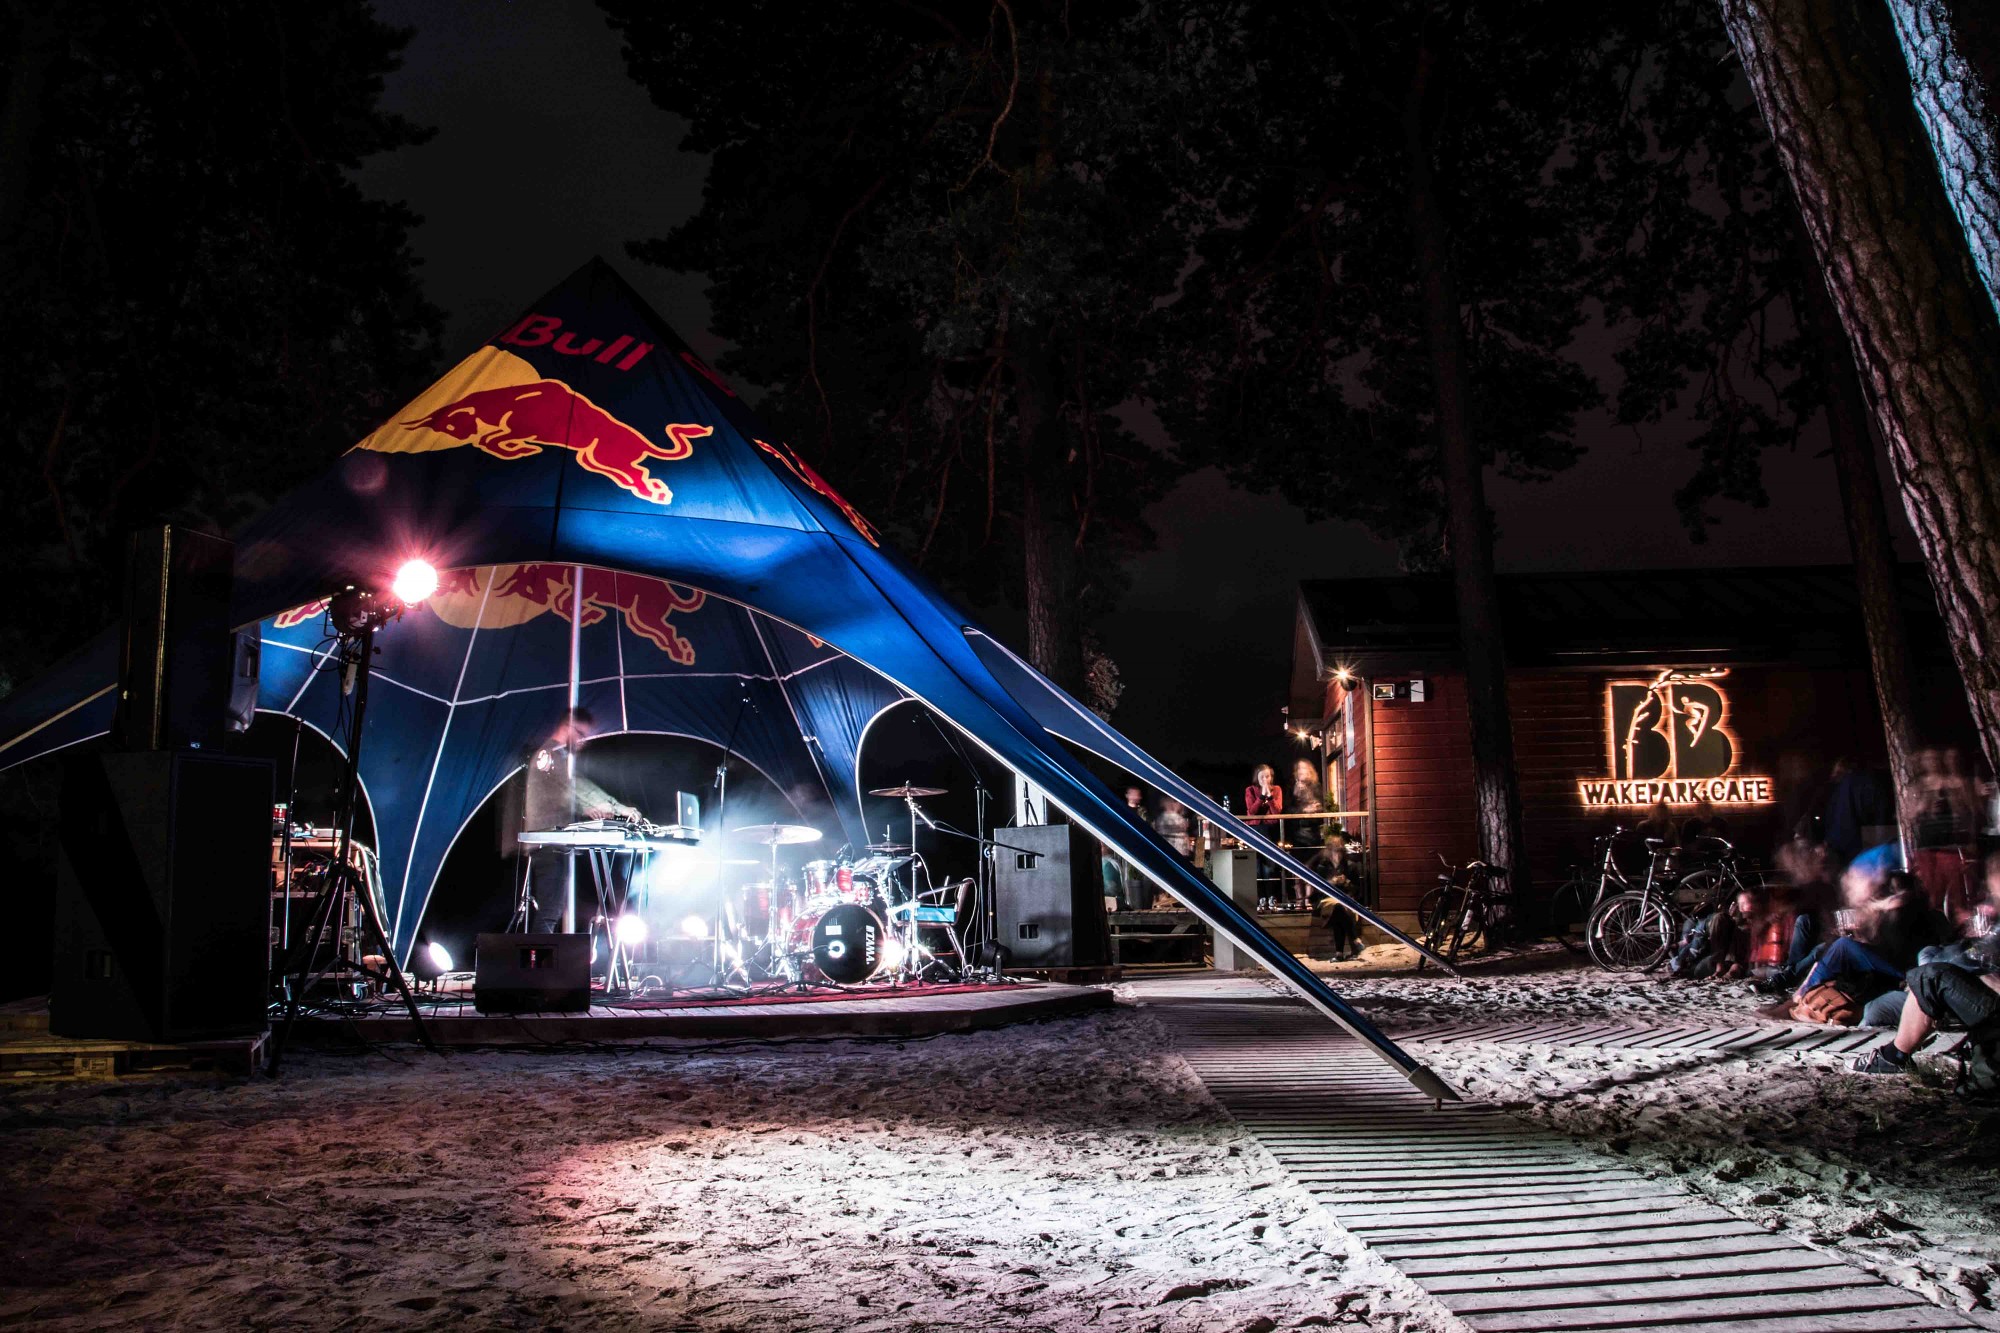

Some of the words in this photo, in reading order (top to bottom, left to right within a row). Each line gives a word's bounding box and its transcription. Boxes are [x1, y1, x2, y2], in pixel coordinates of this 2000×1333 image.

[500, 312, 655, 372] Bull
[1583, 782, 1702, 804] WAKEPARK
[1710, 780, 1769, 801] CAFE
[865, 928, 875, 963] TAMA
